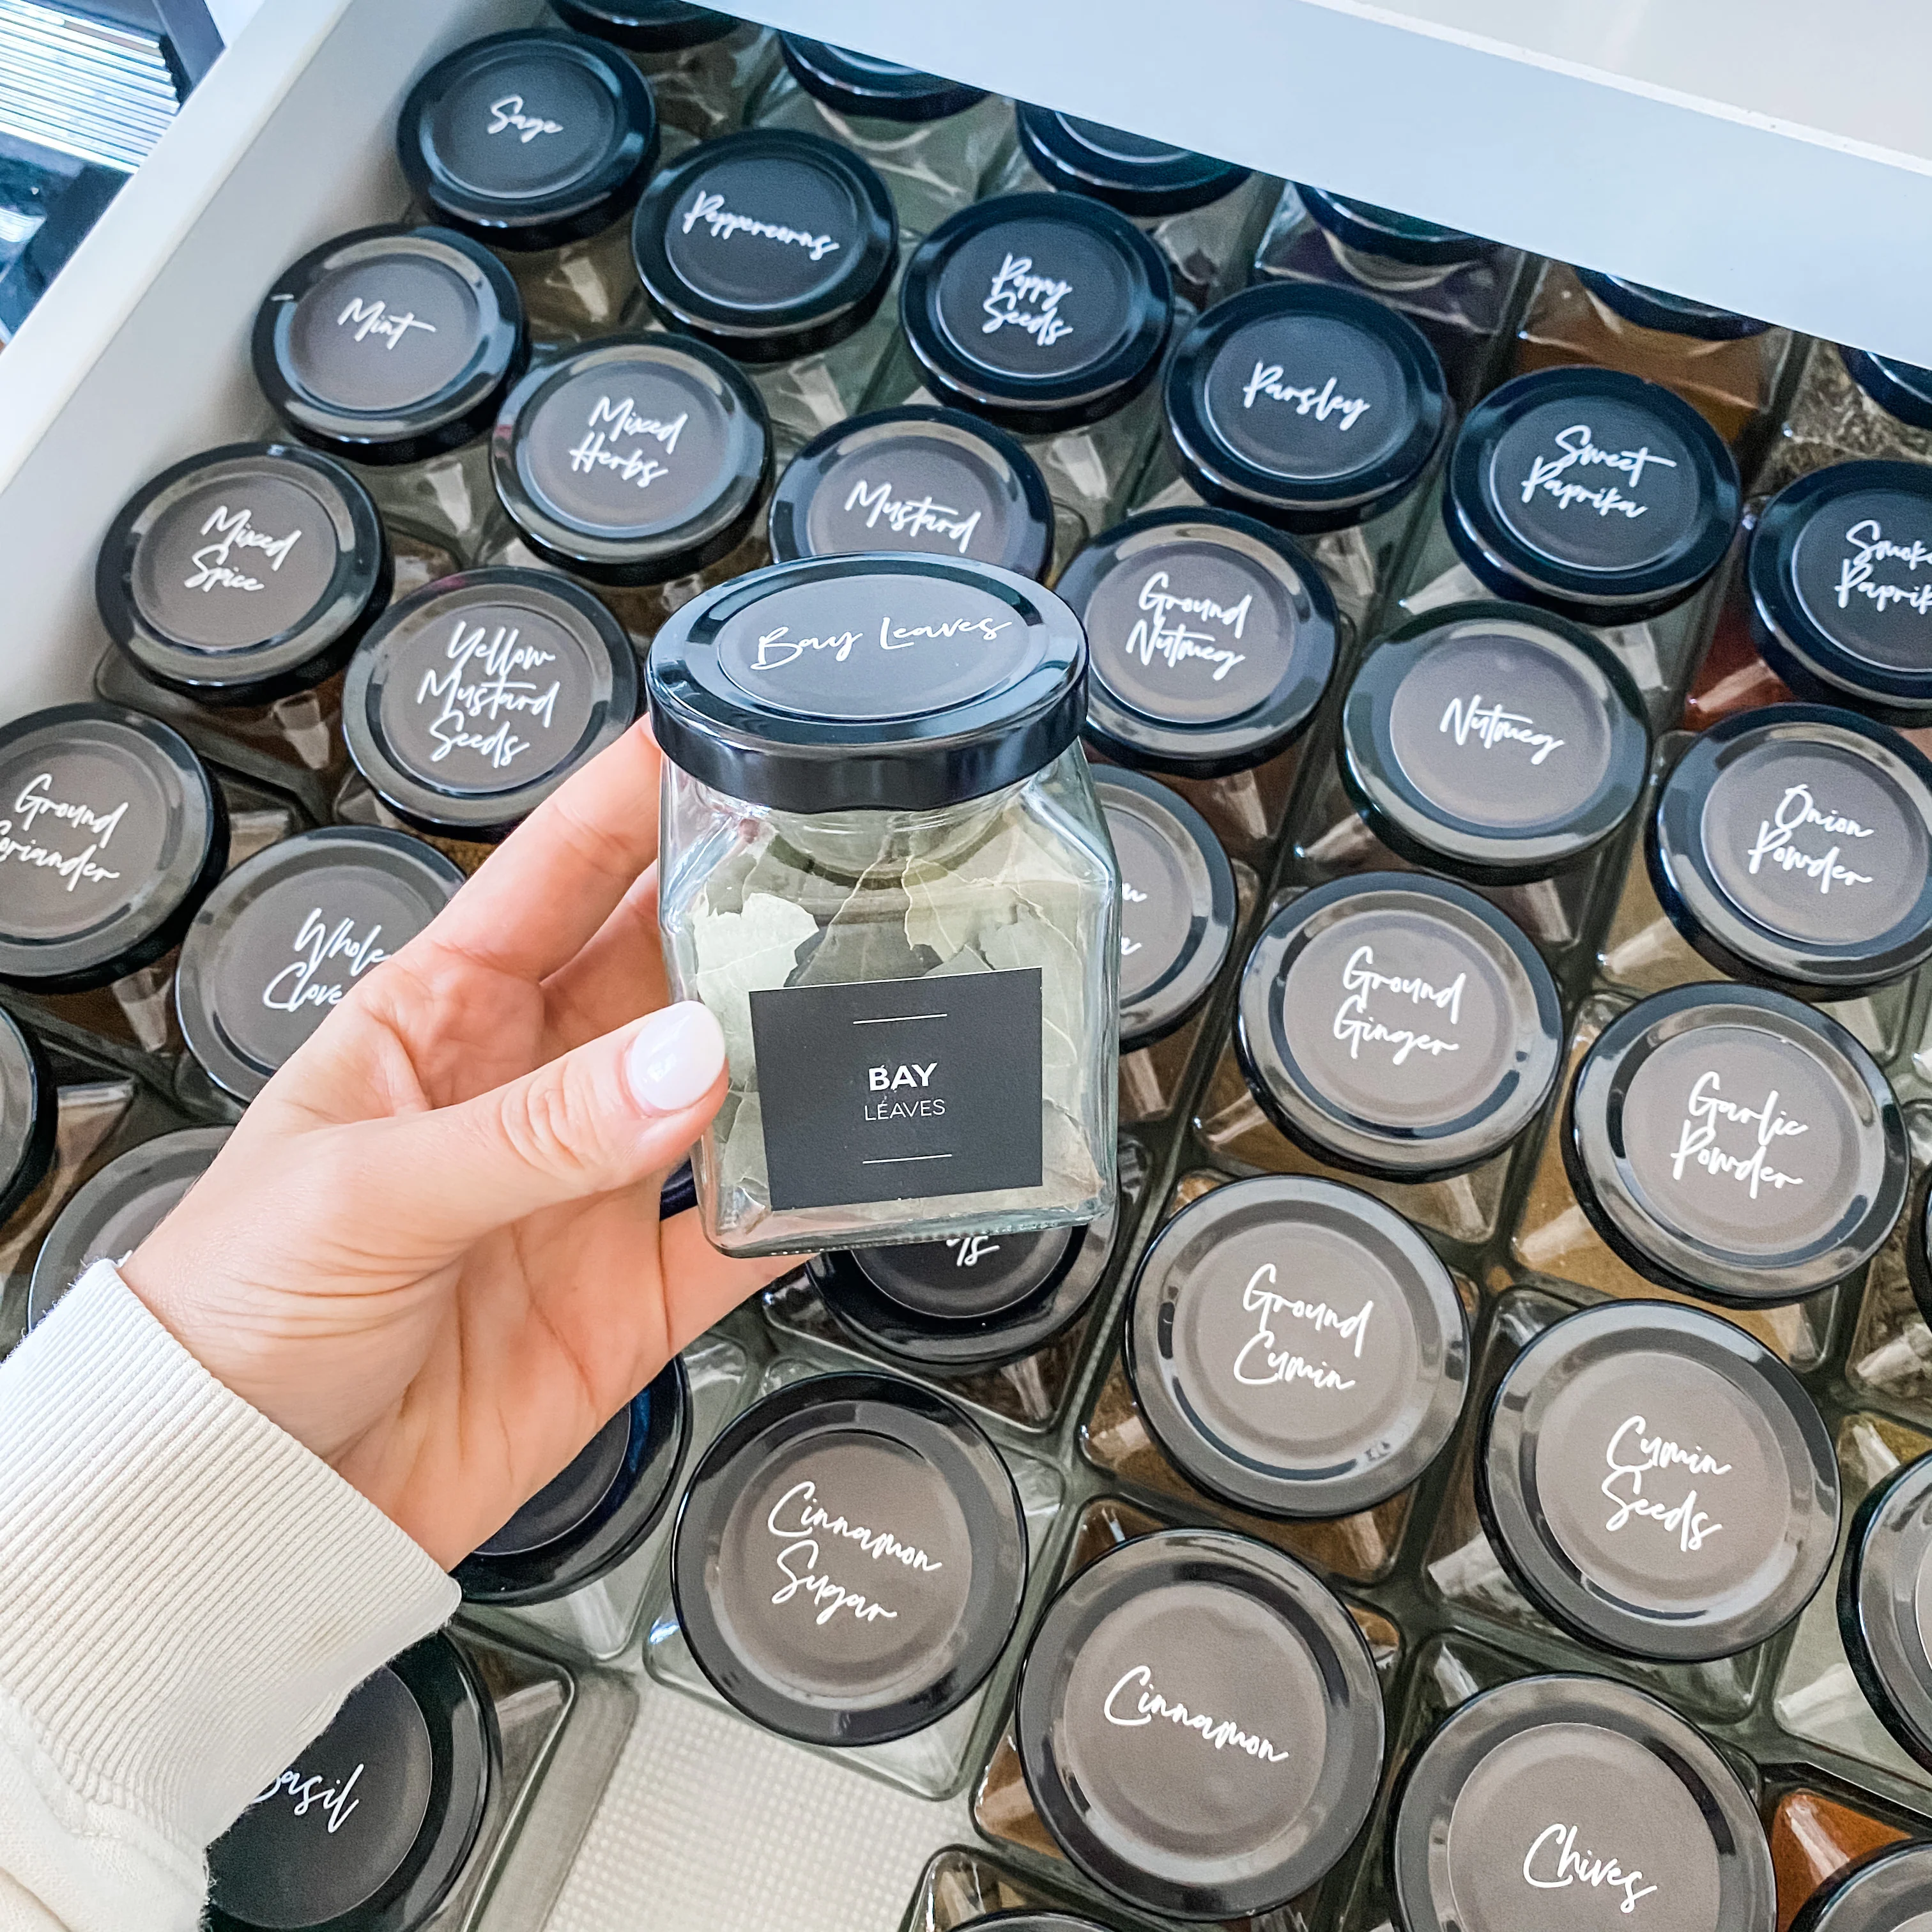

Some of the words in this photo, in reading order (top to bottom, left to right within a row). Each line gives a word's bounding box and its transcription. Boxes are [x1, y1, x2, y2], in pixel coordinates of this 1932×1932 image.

[488, 95, 564, 143] Sage
[682, 190, 839, 260] Peppercorns
[991, 254, 1073, 309] Poppy
[337, 297, 436, 349] Mint
[982, 289, 1073, 346] Seeds
[588, 395, 689, 454] Mixed
[1243, 360, 1371, 431] Parsley
[568, 432, 668, 487] Herbs
[1554, 425, 1677, 486] Sweet
[845, 480, 981, 553] Mustard
[1521, 456, 1648, 518] Paprika
[184, 544, 264, 592] Spice
[201, 505, 301, 571] Mixed
[1845, 519, 1932, 571] Smok
[1138, 571, 1253, 638] Ground
[1834, 559, 1932, 615] Paprik
[445, 620, 556, 677] Yellow
[749, 625, 863, 671] Bay
[878, 615, 1014, 651] Leaves
[1125, 618, 1246, 680] Nutmeg
[416, 668, 561, 726] Mustard
[429, 710, 530, 768] Seeds
[1439, 696, 1565, 765] Nutmeg
[14, 773, 128, 848] Ground
[1775, 785, 1874, 838] Onion
[1748, 820, 1873, 893] Powder
[294, 908, 393, 977] Whole
[263, 962, 344, 1011] Clove
[1342, 946, 1466, 1024] Ground
[1333, 997, 1459, 1064] Ginger
[868, 1062, 937, 1091] BAY
[1688, 1071, 1808, 1144] Garlic
[864, 1098, 946, 1121] LEAVES
[1669, 1119, 1804, 1199] Powder
[1243, 1263, 1373, 1359] Ground
[1232, 1330, 1354, 1393] Cumin
[1606, 1415, 1732, 1476] Cumin
[767, 1480, 942, 1573] Cinnamon
[1601, 1465, 1722, 1551] Seeds
[772, 1541, 898, 1625] Sugar
[1103, 1665, 1289, 1763] Cinnamon
[1523, 1824, 1658, 1913] Chives
